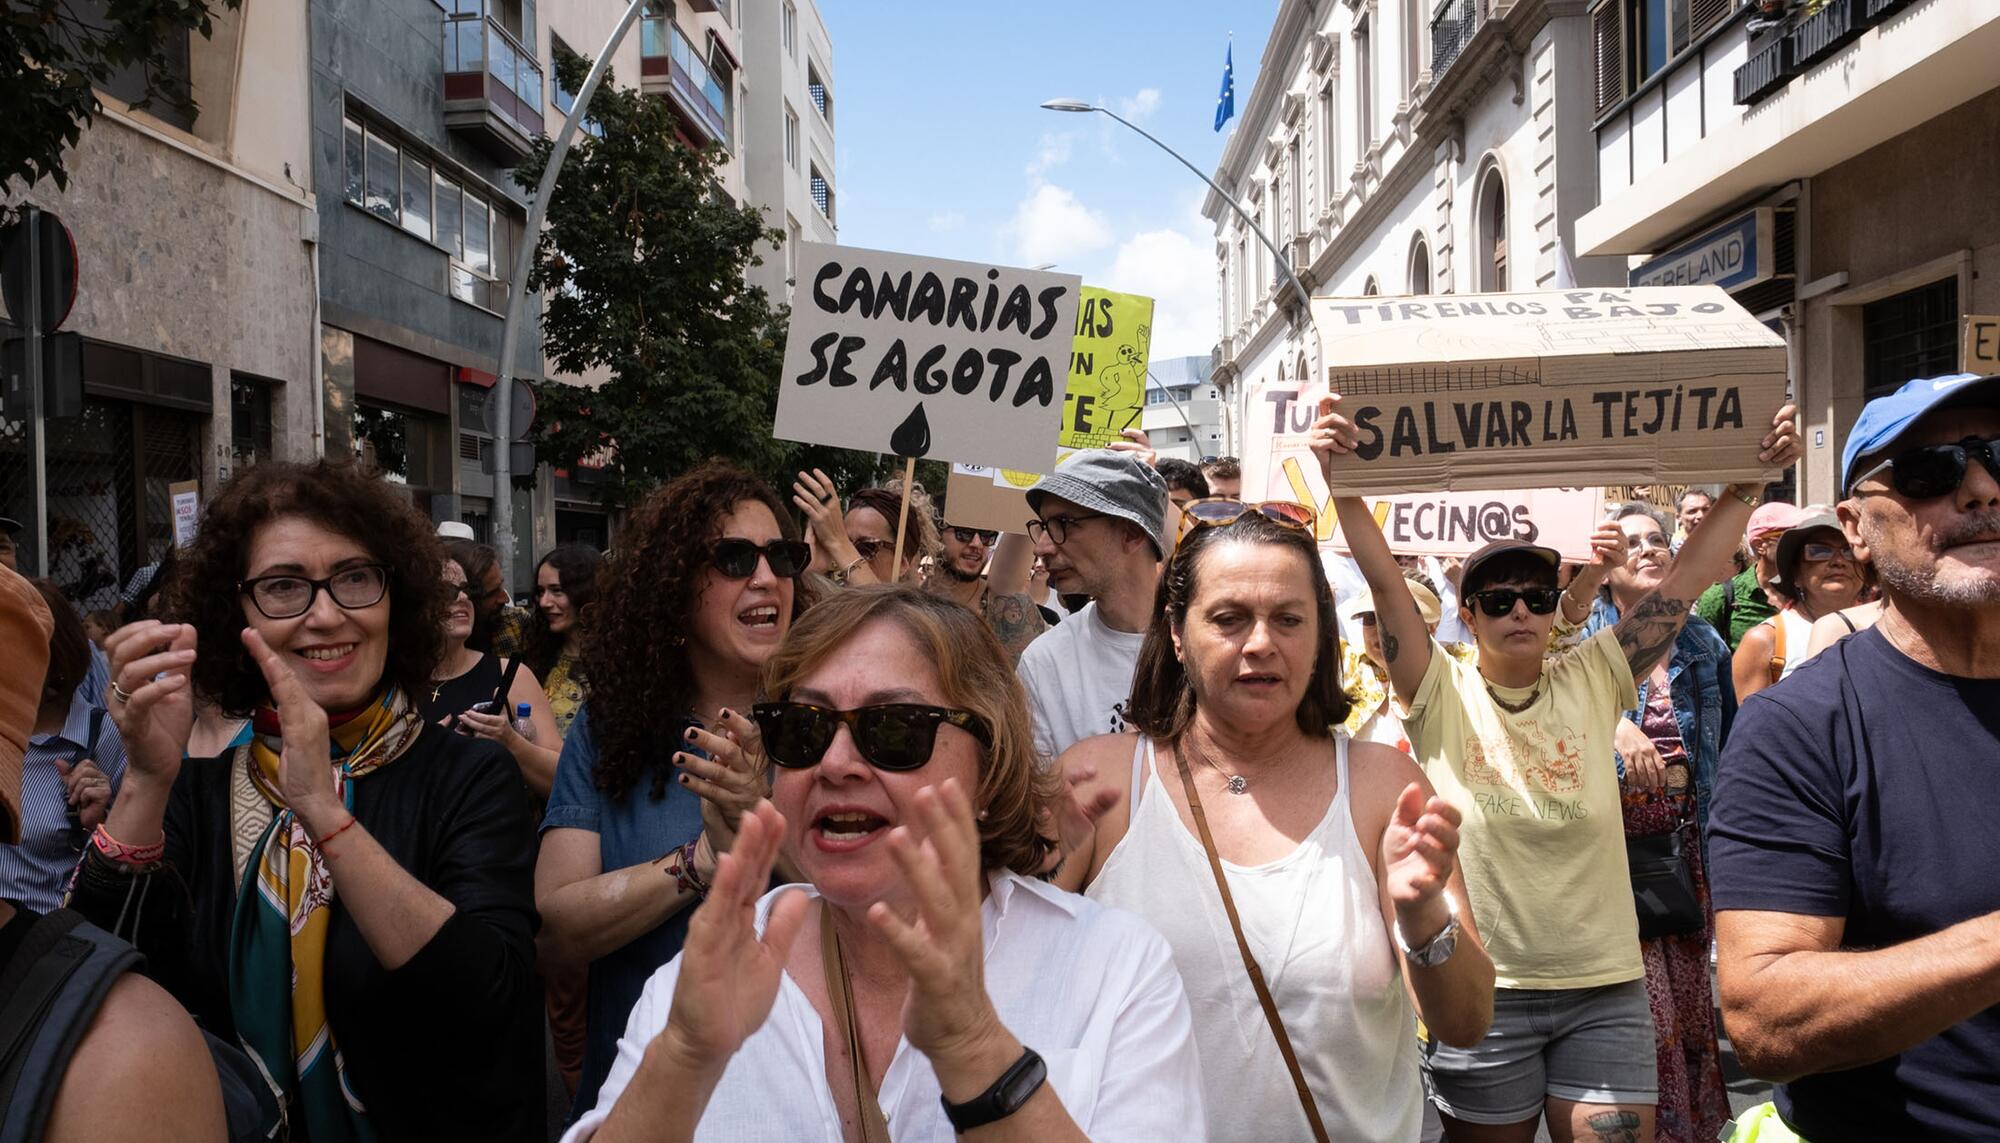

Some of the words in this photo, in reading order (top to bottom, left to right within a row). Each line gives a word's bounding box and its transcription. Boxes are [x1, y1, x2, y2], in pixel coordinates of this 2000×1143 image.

[1329, 301, 1548, 325] TÍRENLOS
[1563, 302, 1725, 320] BAJO
[1975, 323, 2000, 361] E
[796, 332, 866, 387] SE
[869, 338, 1054, 408] AGOTA
[1354, 399, 1533, 461] SALVAR
[1542, 398, 1579, 442] LA
[1473, 793, 1521, 817] FAKE
[1533, 799, 1588, 821] NEWS
